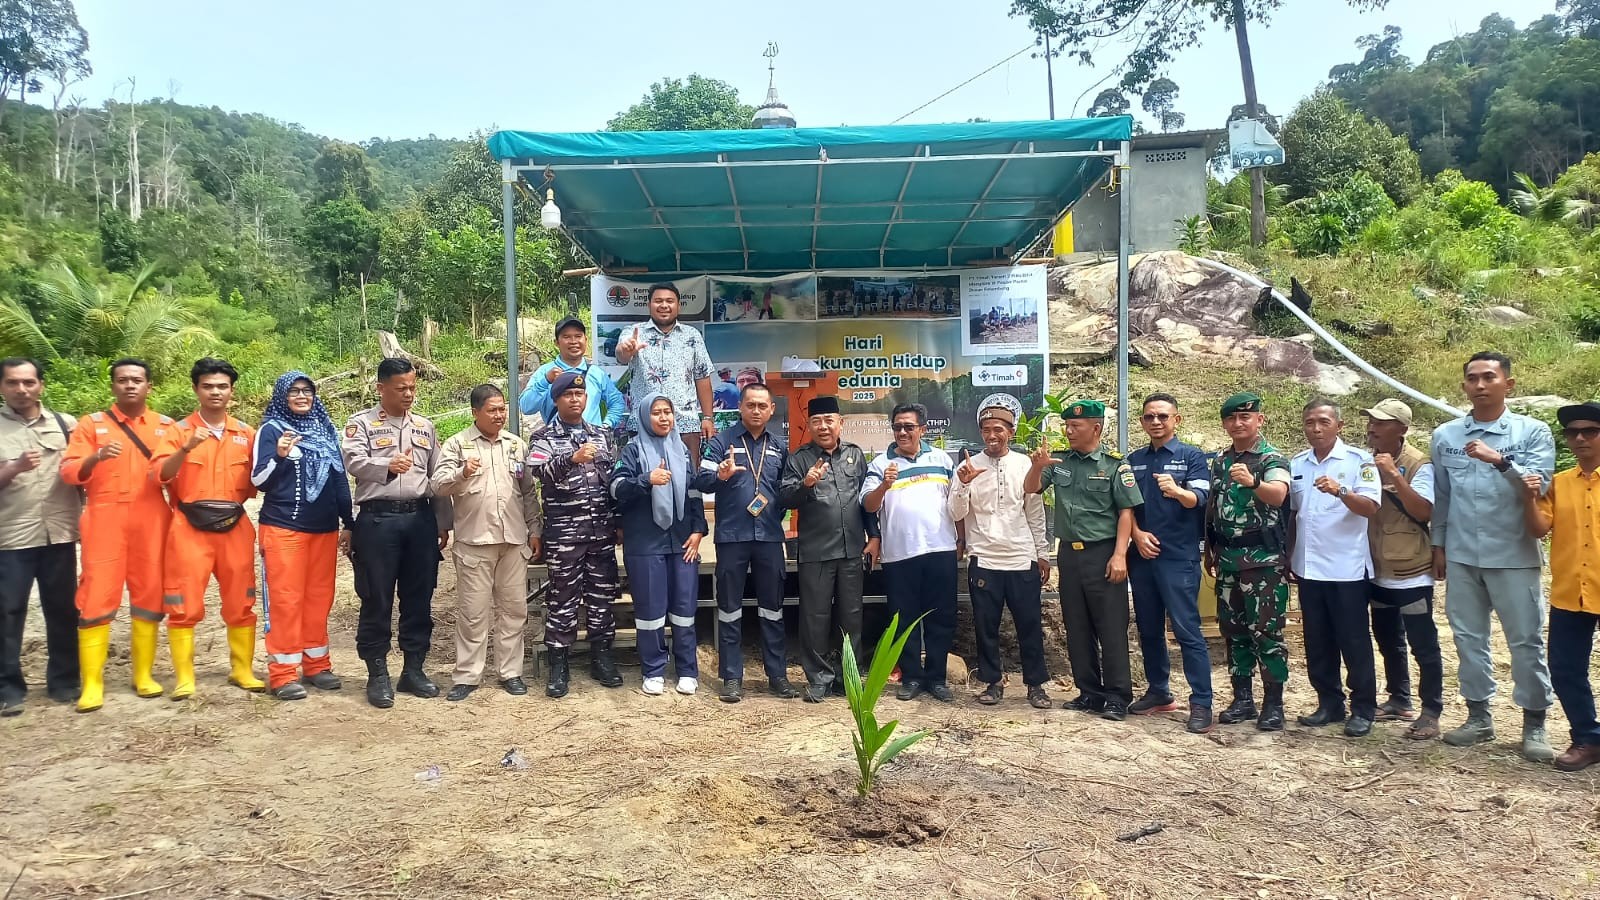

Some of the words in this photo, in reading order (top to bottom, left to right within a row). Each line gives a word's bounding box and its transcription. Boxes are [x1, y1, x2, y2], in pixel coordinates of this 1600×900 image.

[845, 335, 882, 350] Hari
[893, 354, 945, 371] Hidup
[838, 373, 901, 388] edunia
[991, 373, 1015, 381] Timah
[853, 392, 874, 400] 2025
[926, 417, 951, 427] KTHPL)
